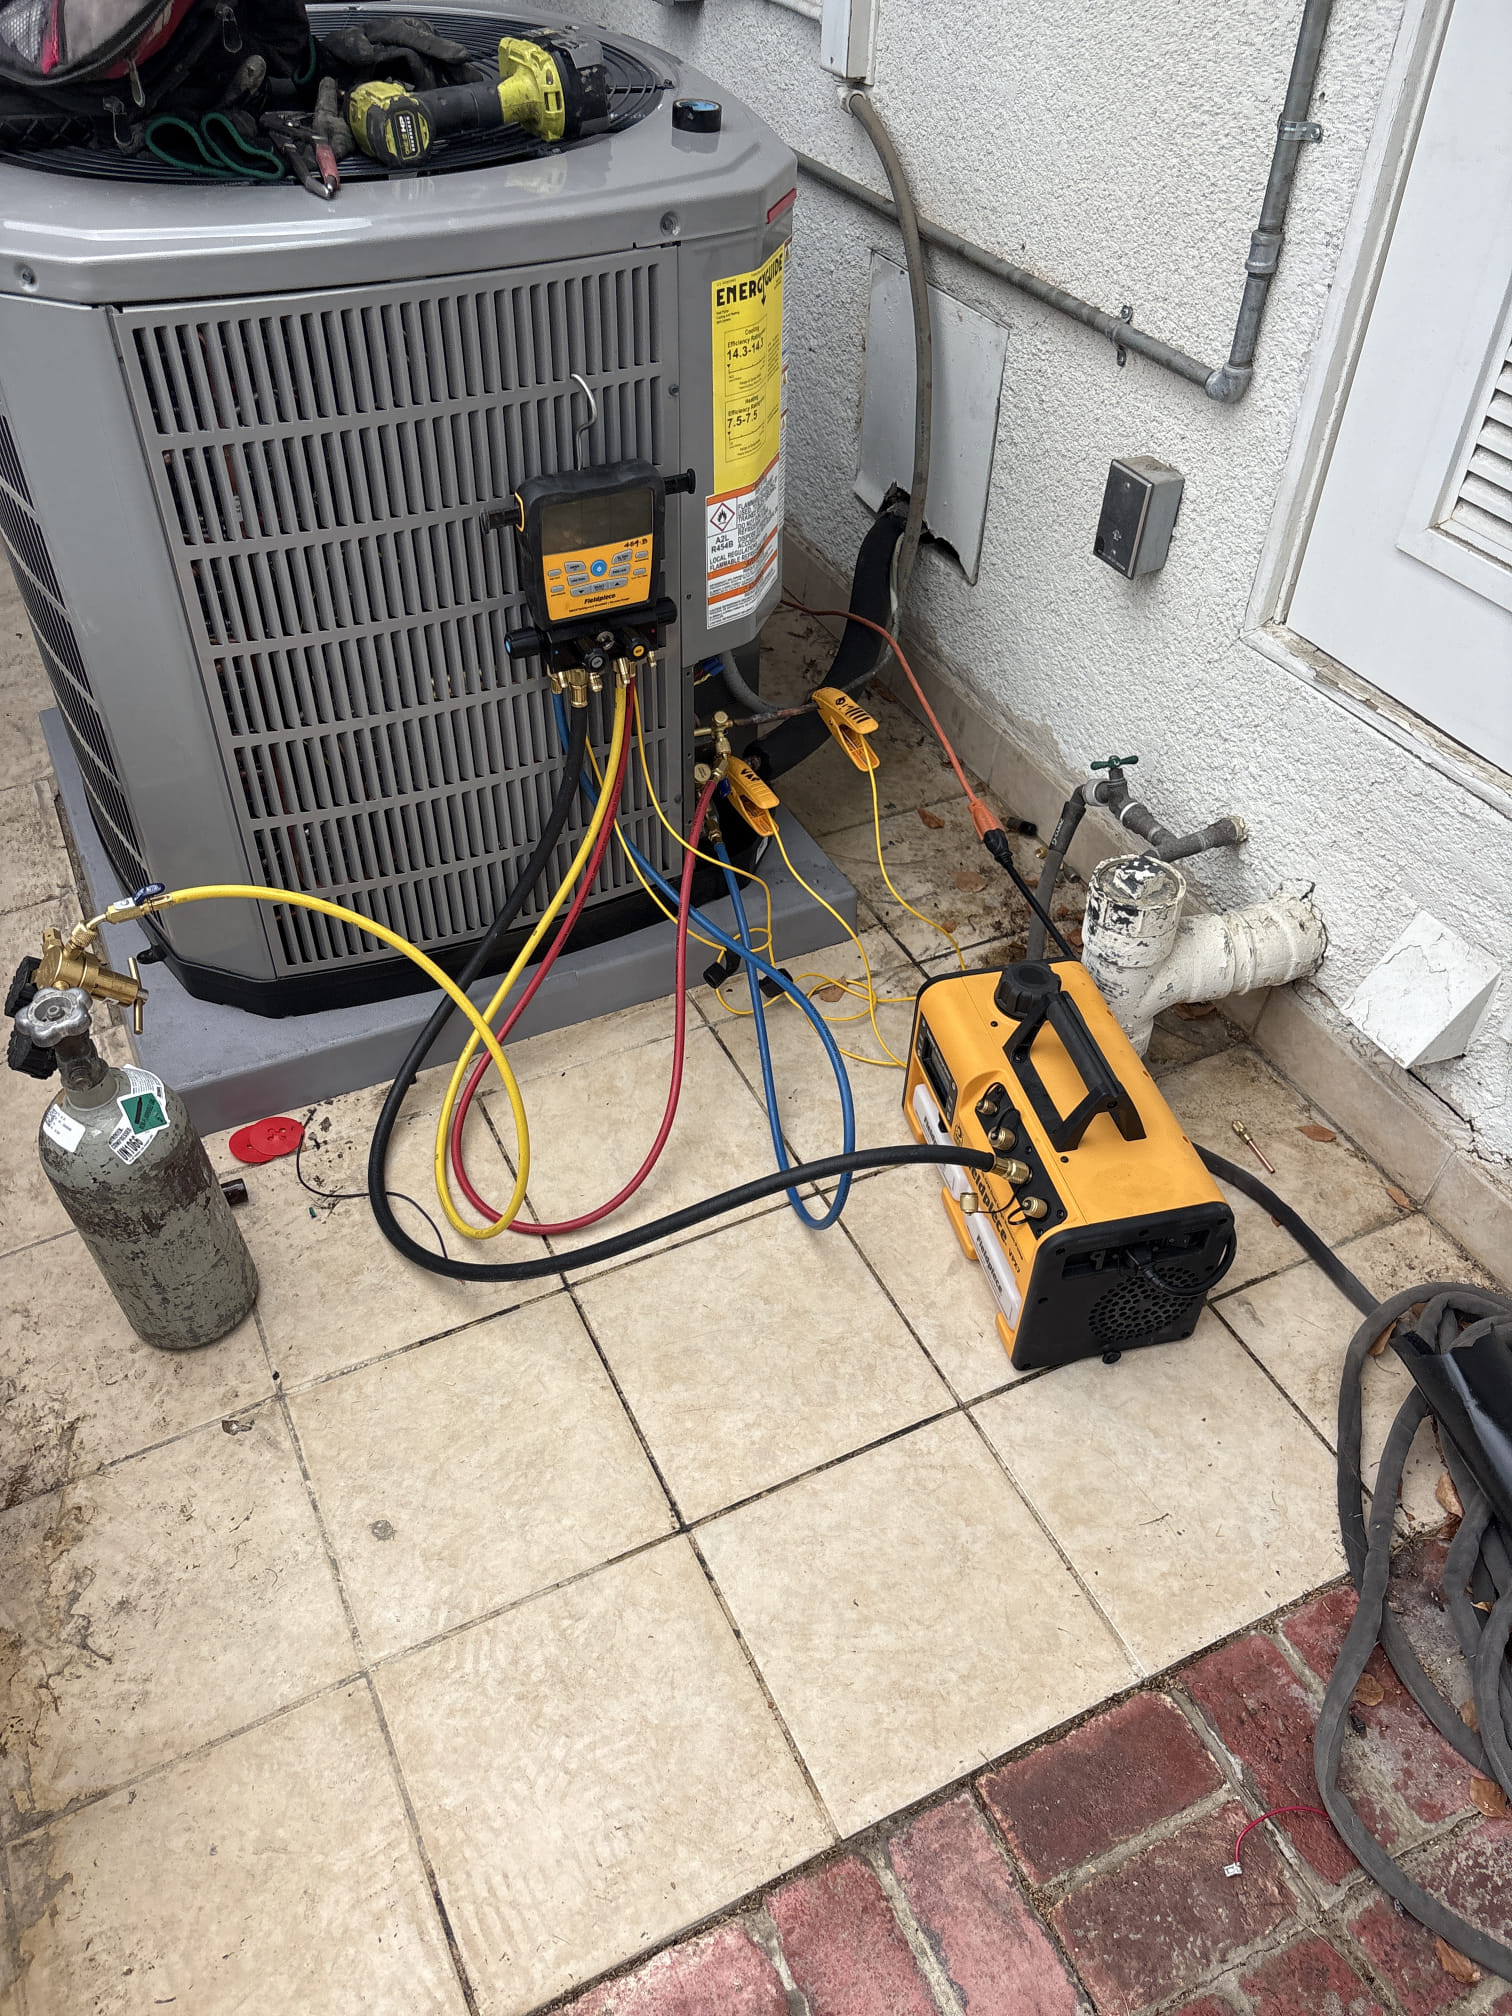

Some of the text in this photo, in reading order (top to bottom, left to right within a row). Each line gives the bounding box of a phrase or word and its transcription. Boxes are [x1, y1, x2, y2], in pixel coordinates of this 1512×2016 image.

[727, 410, 758, 428] 7.5-7.5
[716, 534, 730, 544] A2L
[711, 541, 734, 553] R454B
[709, 554, 726, 564] LOCAL
[584, 593, 616, 604] Fieldpiece
[976, 1236, 1003, 1292] Fieldpiece
